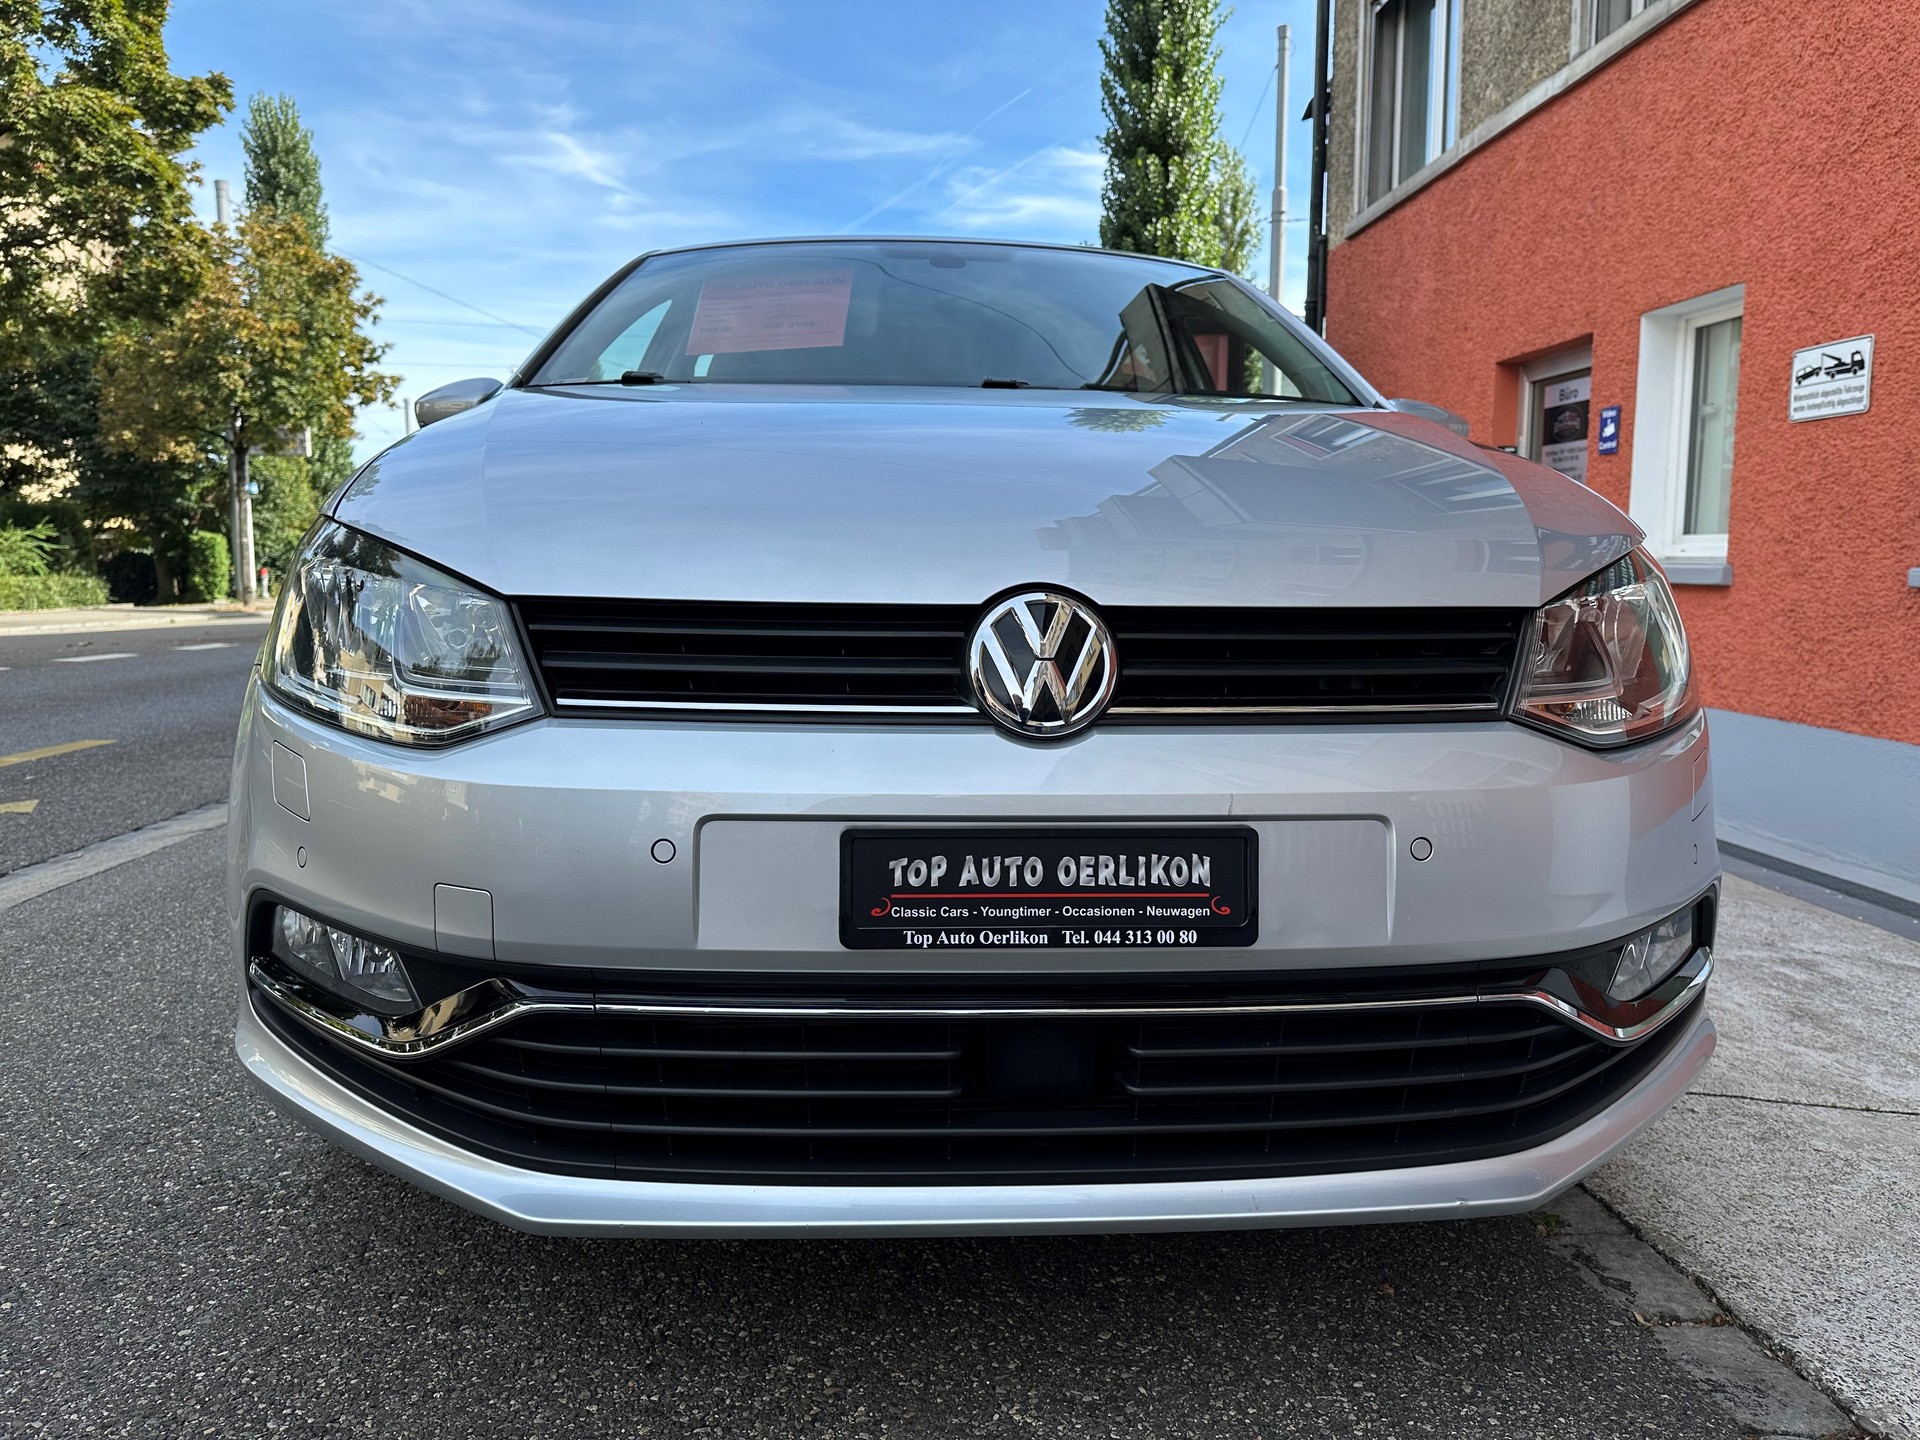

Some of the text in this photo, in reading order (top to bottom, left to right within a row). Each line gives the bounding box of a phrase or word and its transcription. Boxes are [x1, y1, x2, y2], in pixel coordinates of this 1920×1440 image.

[778, 276, 846, 288] OERLIKON
[1559, 387, 1579, 402] Büro
[889, 853, 1211, 888] TOP AUTO OERLIKON
[891, 906, 937, 918] Classic
[941, 906, 969, 918] Cars
[980, 906, 1051, 919] Youngtimer
[1062, 906, 1135, 917] Occasionen
[1146, 906, 1211, 919] Neuwagen
[903, 930, 1198, 947] Top Auto Oerlikon Tel. 044 313 00 80
